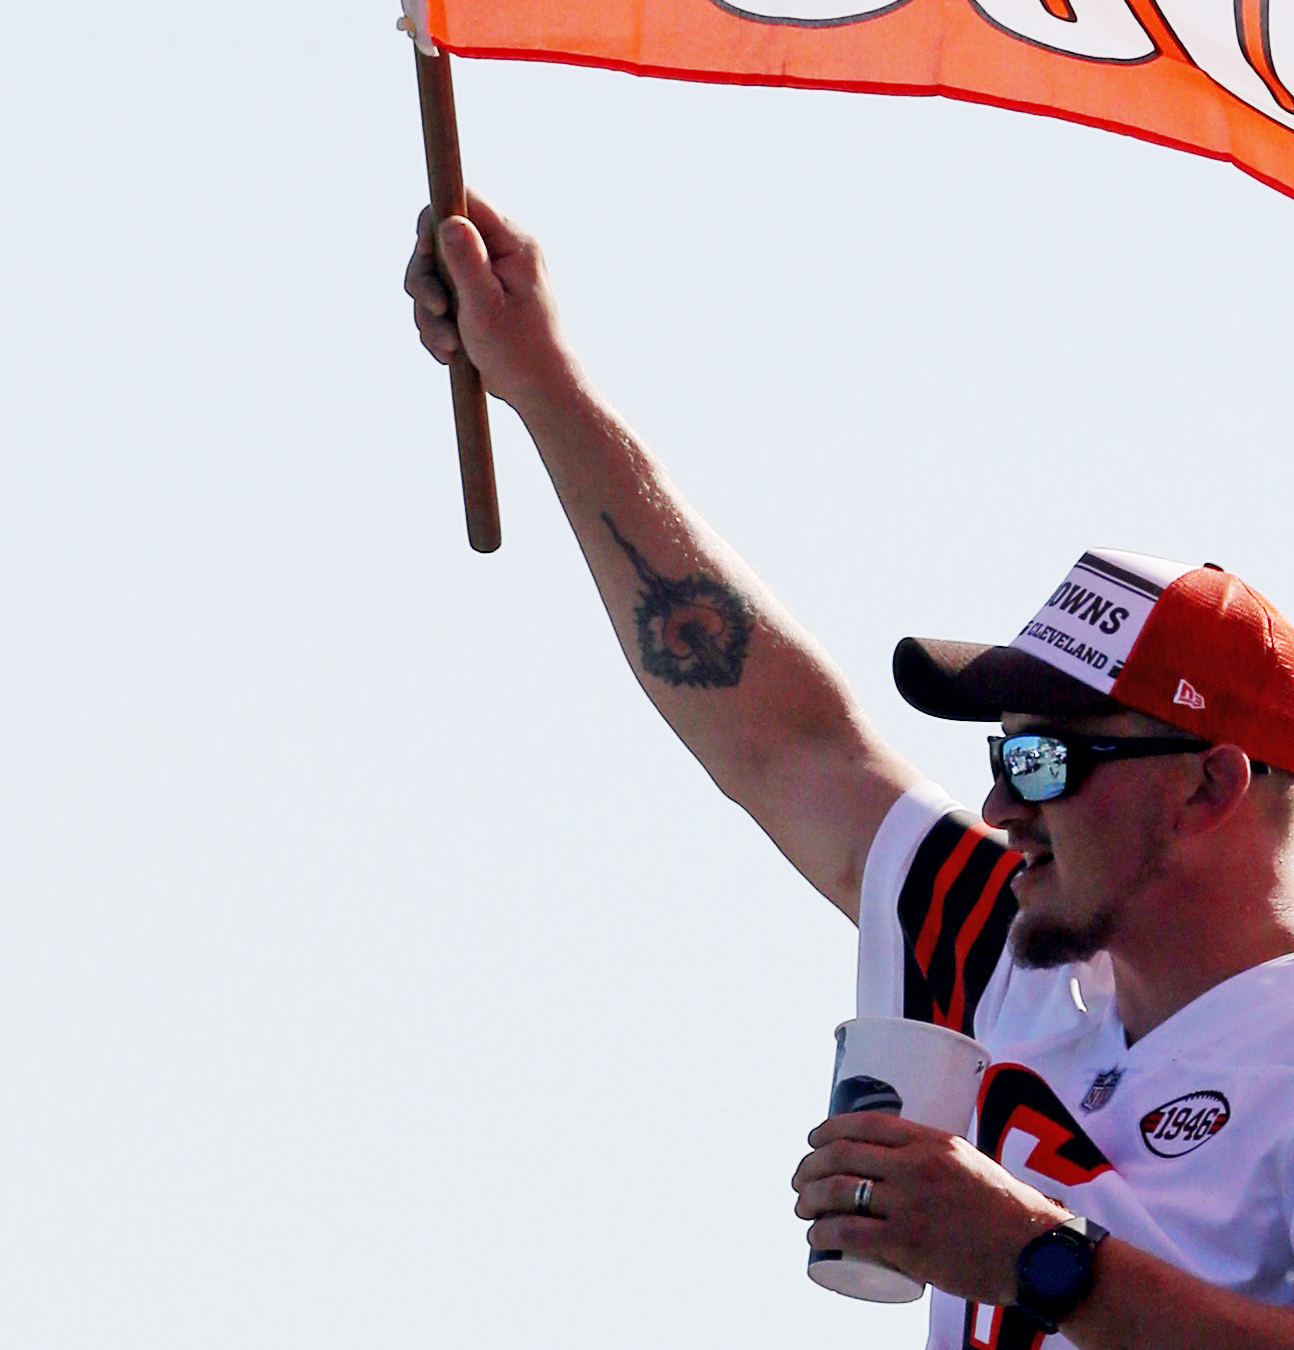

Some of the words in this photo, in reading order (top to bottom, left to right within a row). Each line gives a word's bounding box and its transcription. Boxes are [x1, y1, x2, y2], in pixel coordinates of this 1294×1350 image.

[1045, 581, 1130, 635] OWNS
[1027, 622, 1109, 670] CLEVELAND
[1153, 1106, 1220, 1141] 1946
